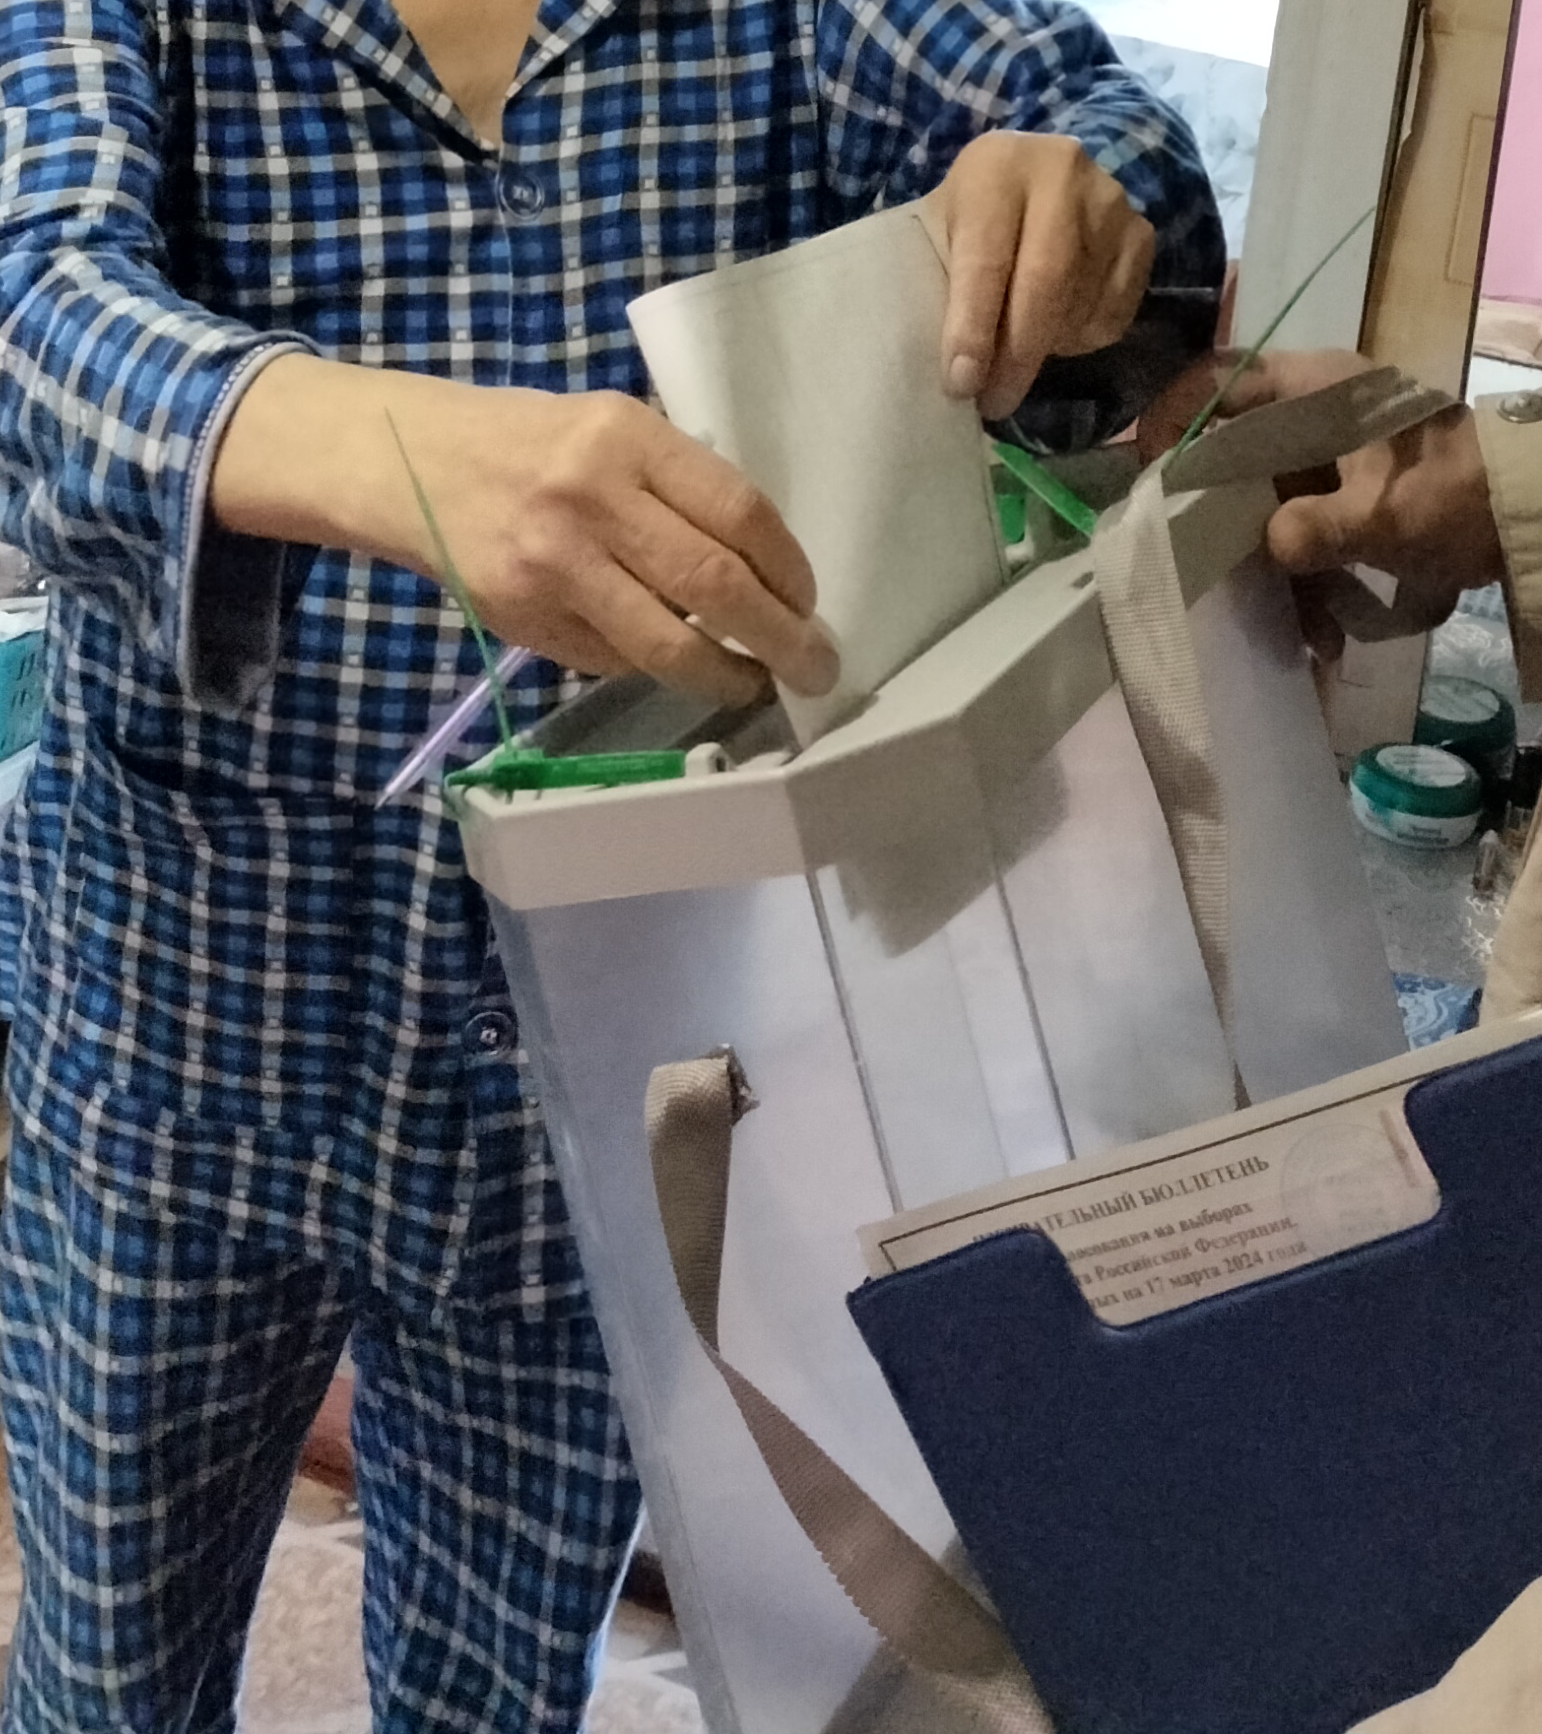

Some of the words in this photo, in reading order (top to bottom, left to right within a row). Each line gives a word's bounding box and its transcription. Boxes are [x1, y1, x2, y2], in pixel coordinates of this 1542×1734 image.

[1139, 1156, 1270, 1206] БЮЛЛЕТЕНЬ
[1179, 1203, 1253, 1232] выборах
[1094, 1246, 1192, 1281] Российской
[1146, 1276, 1164, 1294] 17
[1169, 1266, 1221, 1287] марта
[1222, 1250, 1264, 1274] 2024
[1266, 1242, 1308, 1262] года
